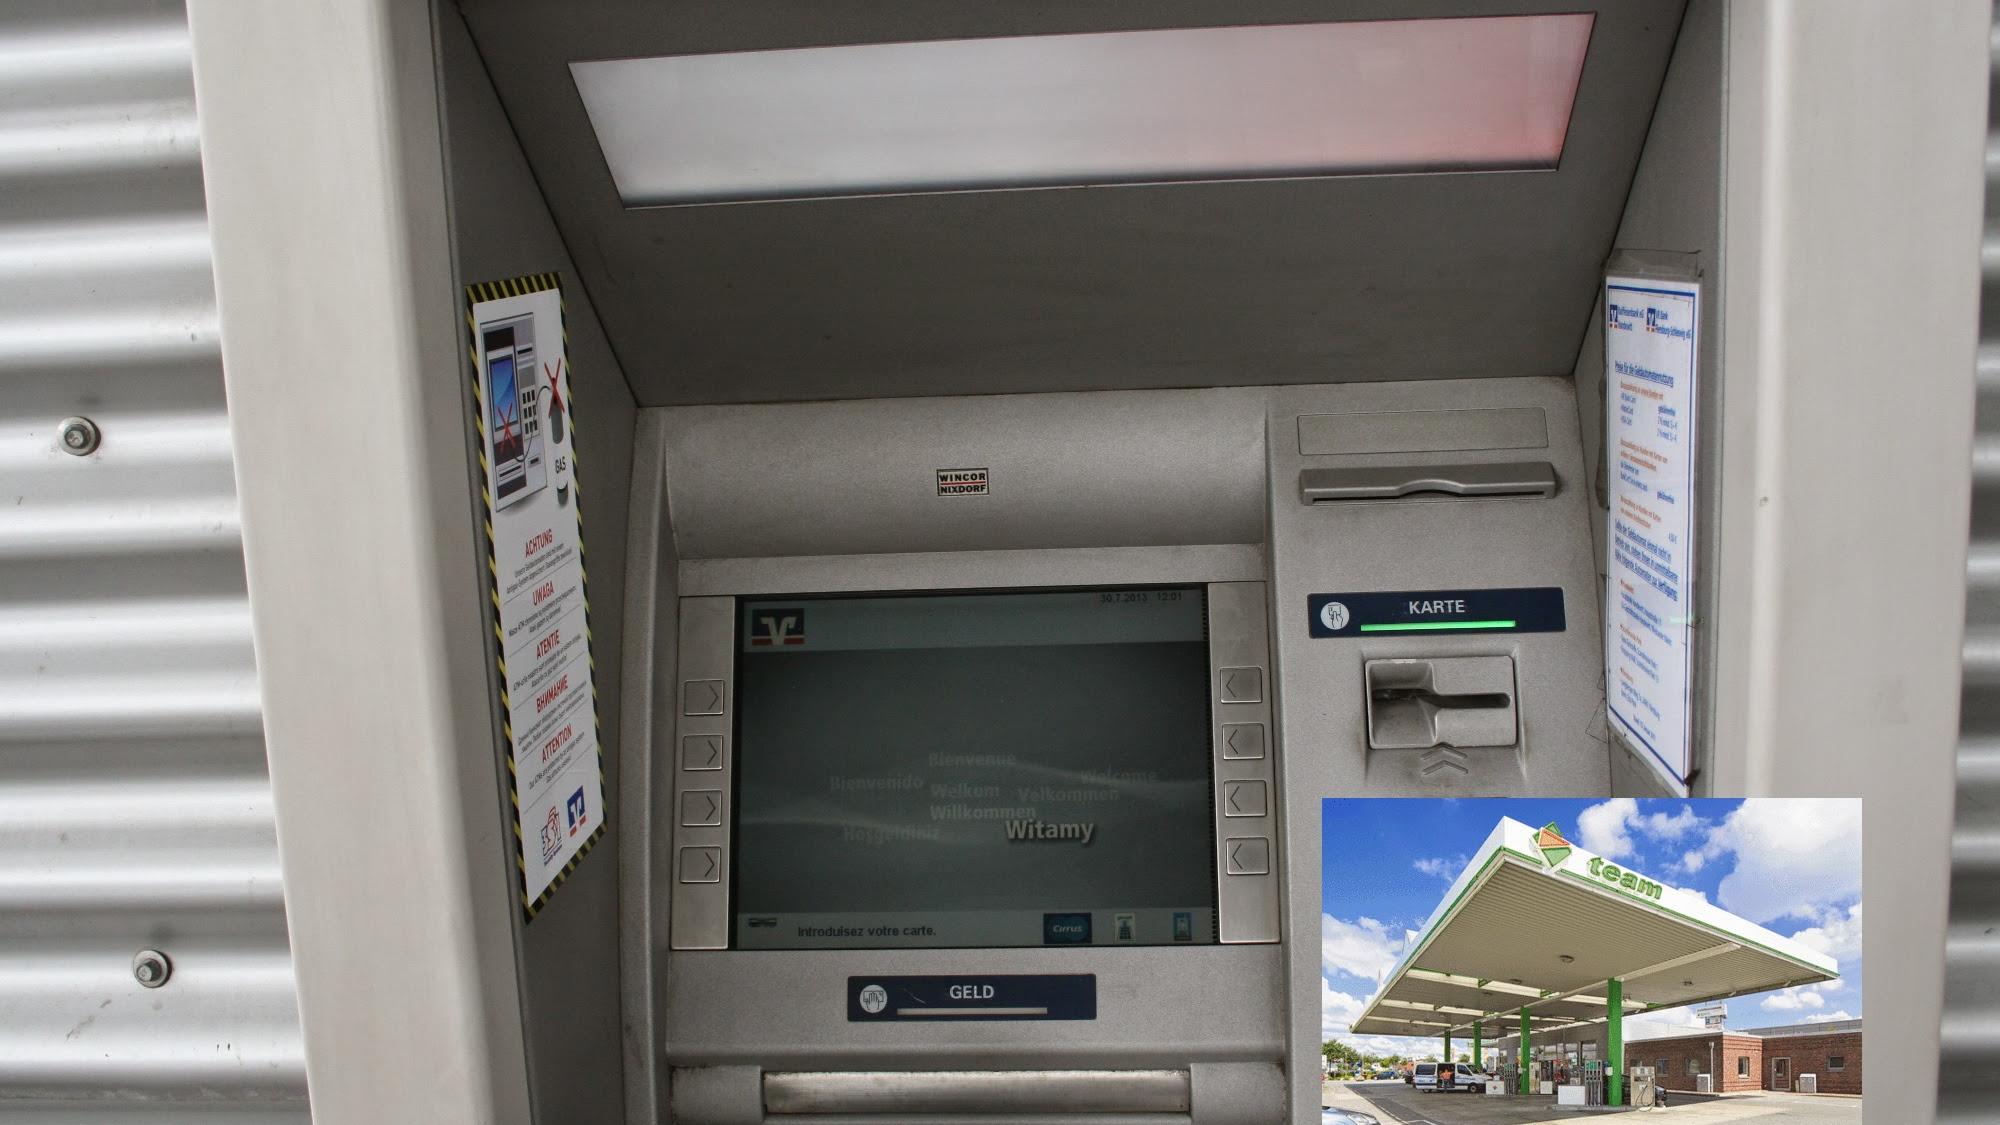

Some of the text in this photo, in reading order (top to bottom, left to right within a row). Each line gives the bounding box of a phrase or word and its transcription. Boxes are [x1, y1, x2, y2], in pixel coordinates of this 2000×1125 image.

[555, 455, 566, 474] GAS
[939, 473, 986, 481] WINCOR
[940, 485, 986, 493] NIXDORF
[525, 528, 553, 557] ACHTUNG
[532, 580, 555, 606] UWAGA
[1408, 600, 1465, 615] KARTE
[536, 673, 569, 714] ВНИМАНИЕ
[541, 722, 573, 763] ATTENTION
[931, 783, 1000, 798] Welkom
[930, 804, 1036, 820] Willkommen
[1006, 819, 1094, 843] Witamy
[1588, 857, 1663, 900] team
[798, 925, 936, 937] Introduisez votre carte.
[1053, 924, 1083, 933] Cirrus
[949, 985, 995, 999] GELD
